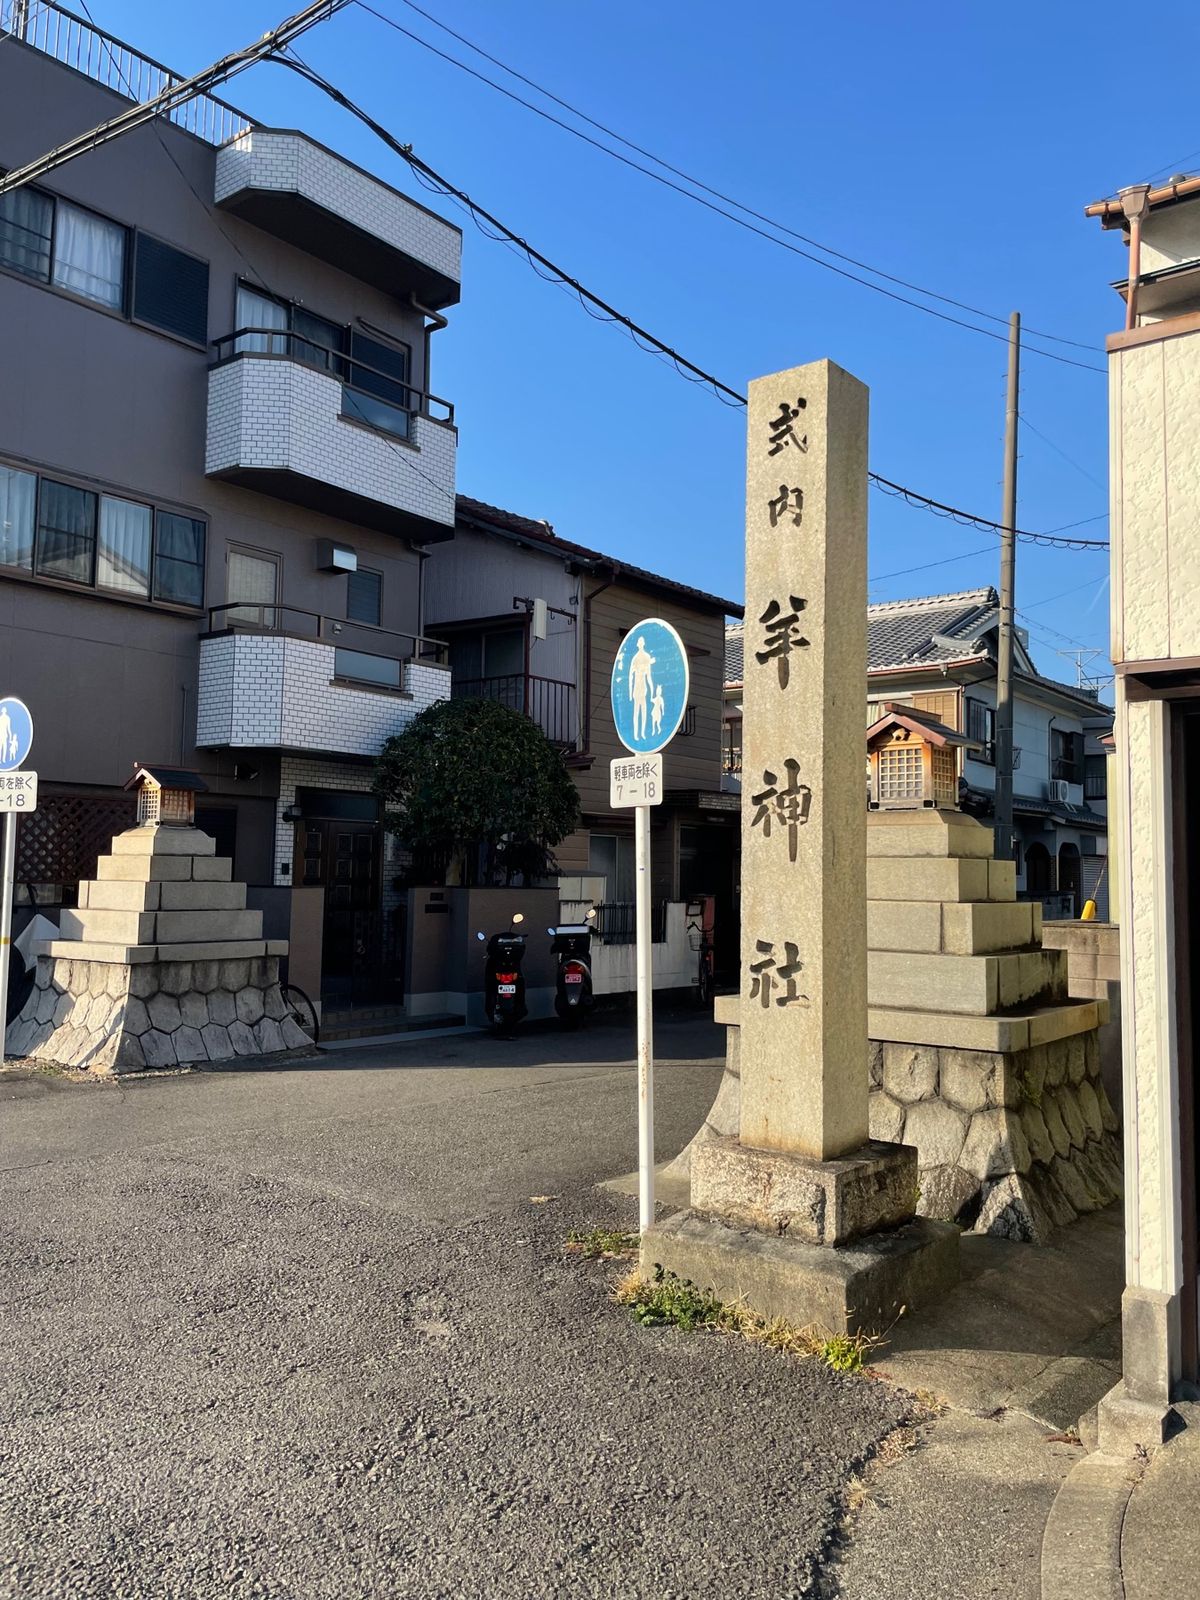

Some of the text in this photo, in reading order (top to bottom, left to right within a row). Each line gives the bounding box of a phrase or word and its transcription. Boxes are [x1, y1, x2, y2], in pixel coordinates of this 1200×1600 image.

[614, 762, 658, 781] 軽車両を除く
